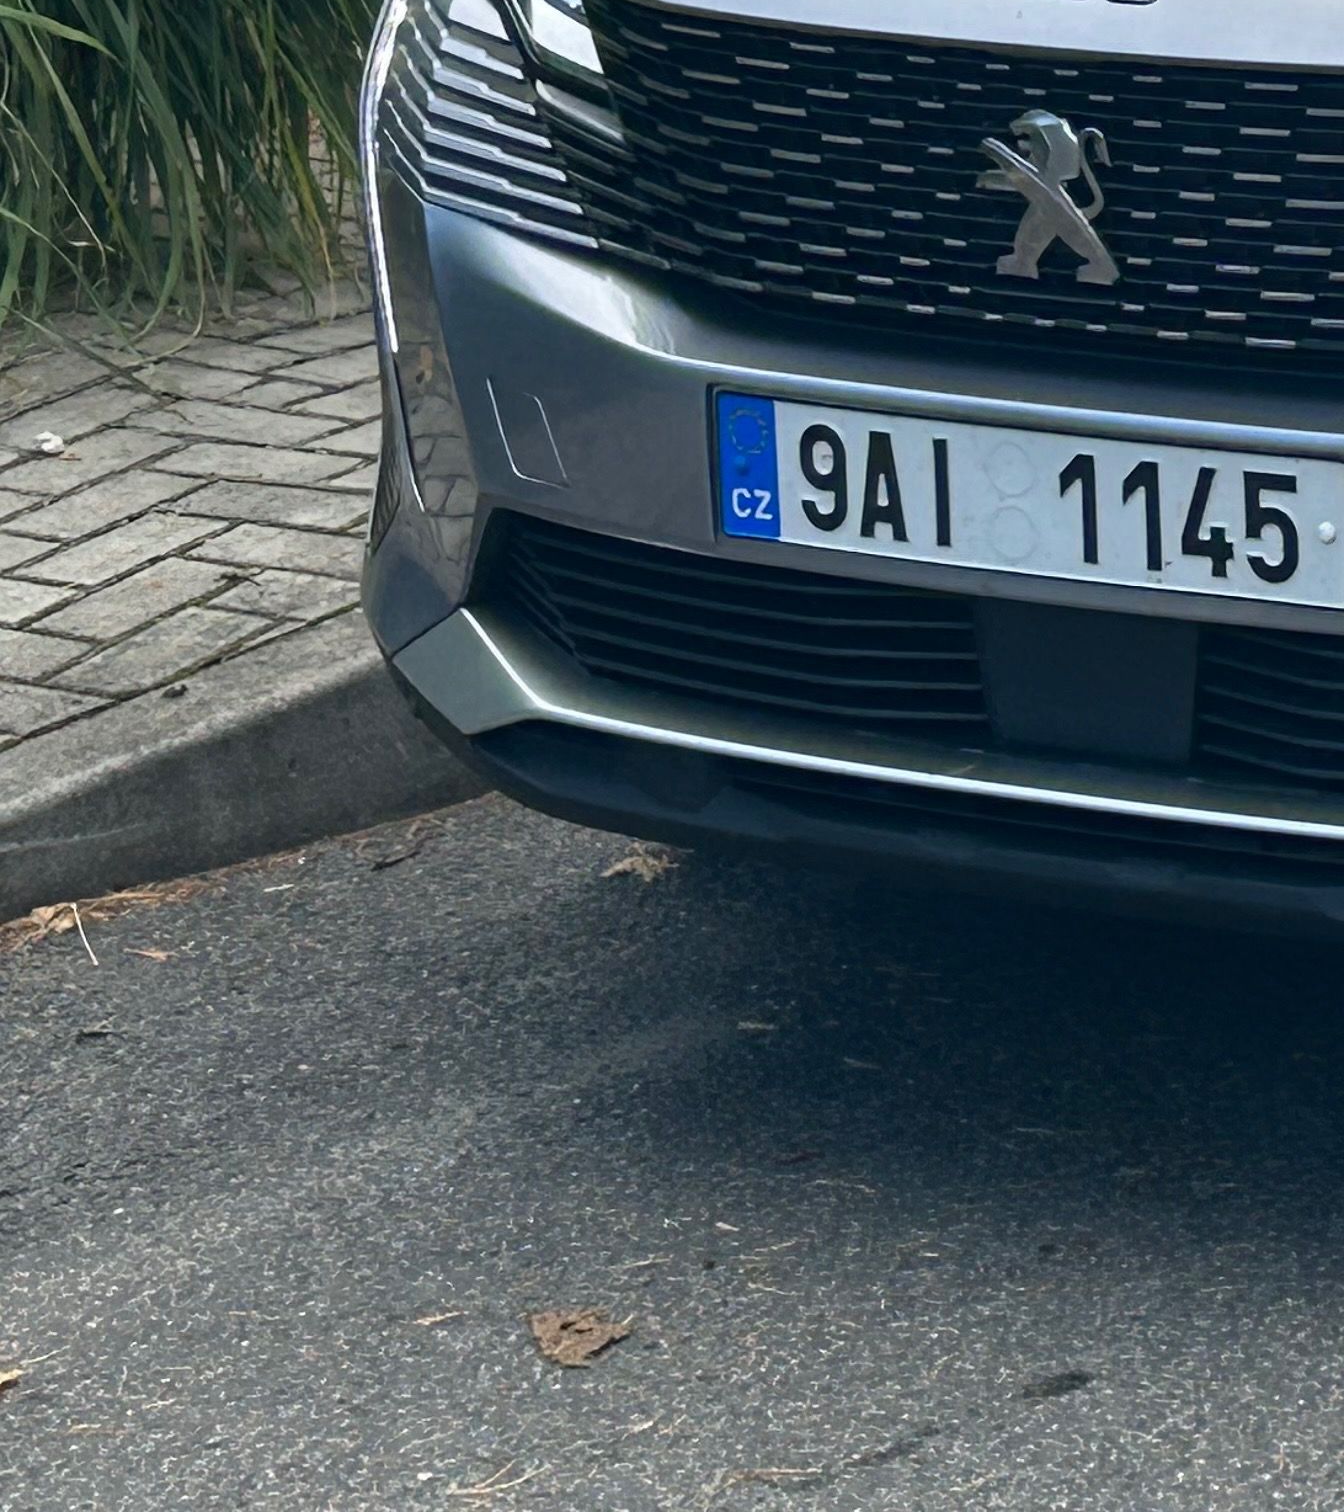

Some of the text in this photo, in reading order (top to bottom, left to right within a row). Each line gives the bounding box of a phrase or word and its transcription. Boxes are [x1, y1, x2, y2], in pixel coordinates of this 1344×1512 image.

[731, 487, 774, 520] CZ
[800, 424, 1300, 583] 9AI 1145
